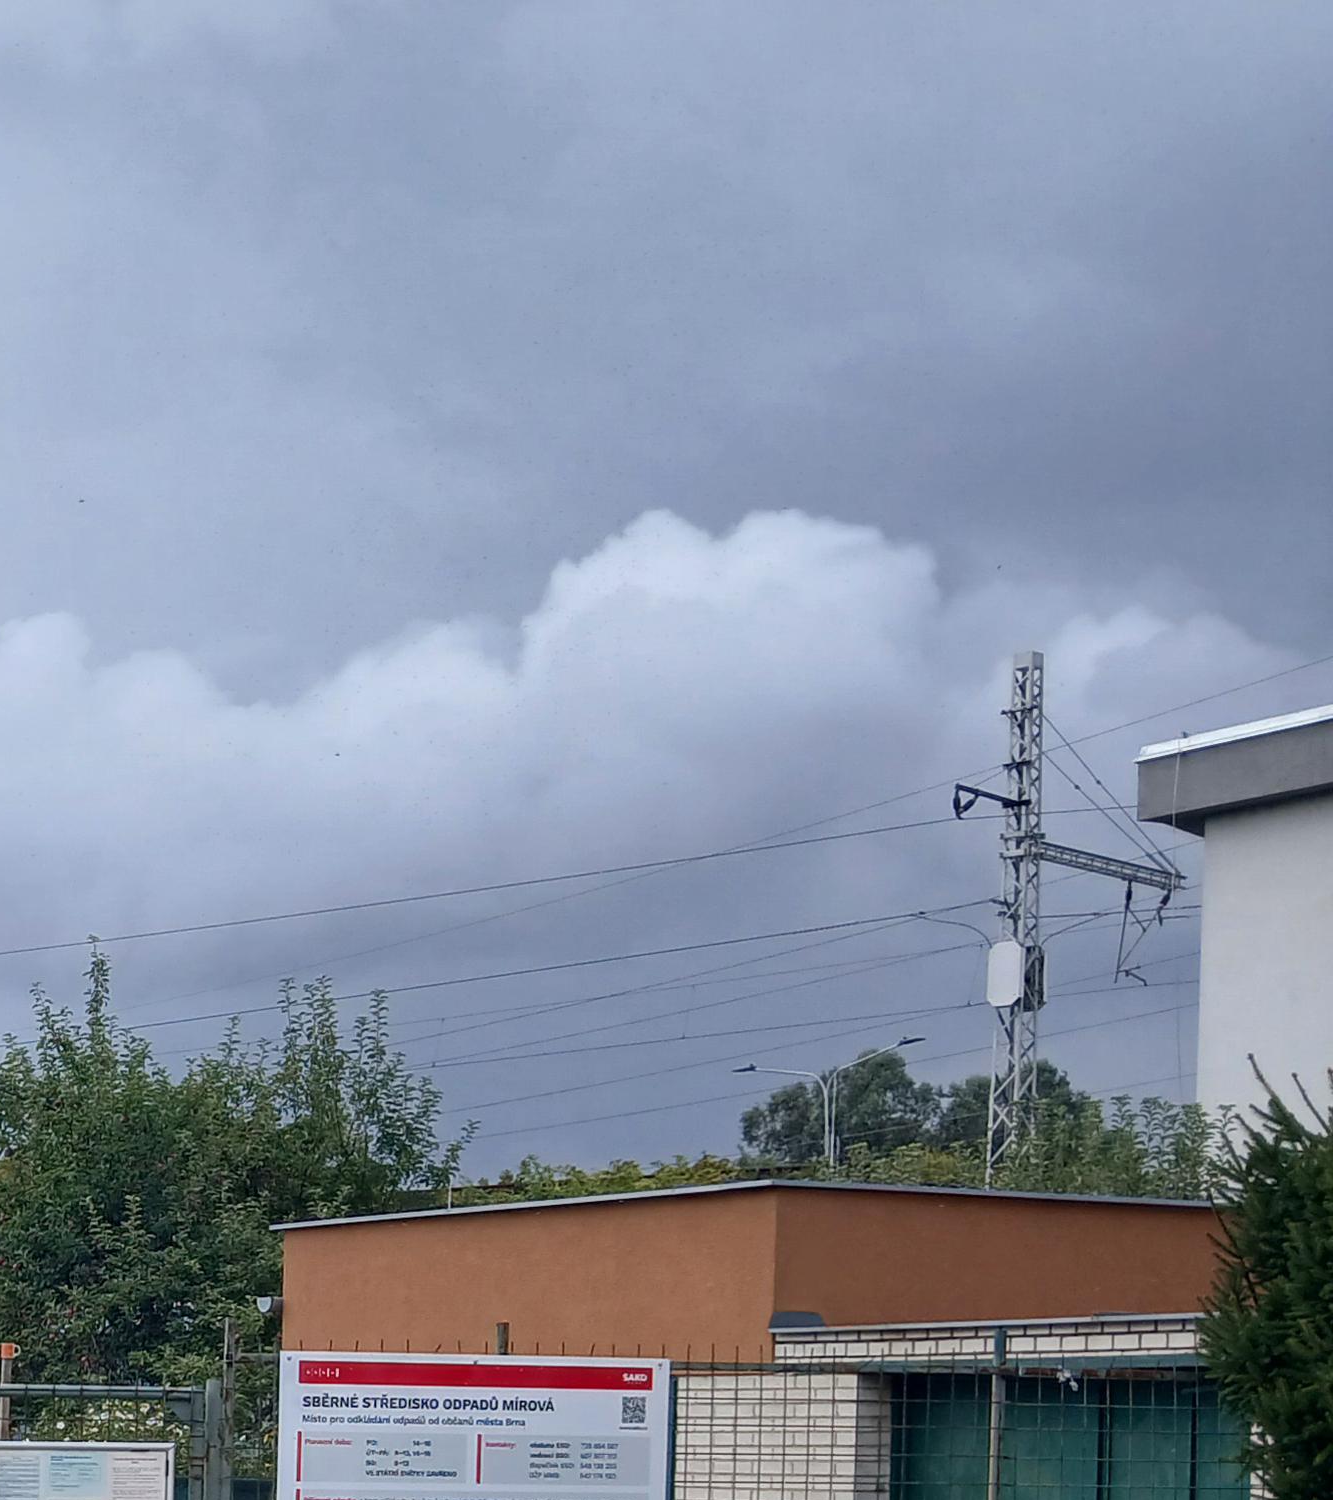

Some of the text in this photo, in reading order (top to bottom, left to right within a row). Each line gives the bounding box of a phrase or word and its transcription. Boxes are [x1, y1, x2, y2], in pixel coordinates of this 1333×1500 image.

[622, 1372, 648, 1382] SAKO
[302, 1393, 555, 1412] SBĚRNÉ STŘEDISKO ODPADŮ MÍROVÁ
[302, 1413, 328, 1424] Místo
[329, 1415, 345, 1426] pro
[428, 1416, 440, 1425] od
[505, 1418, 526, 1427] Brna
